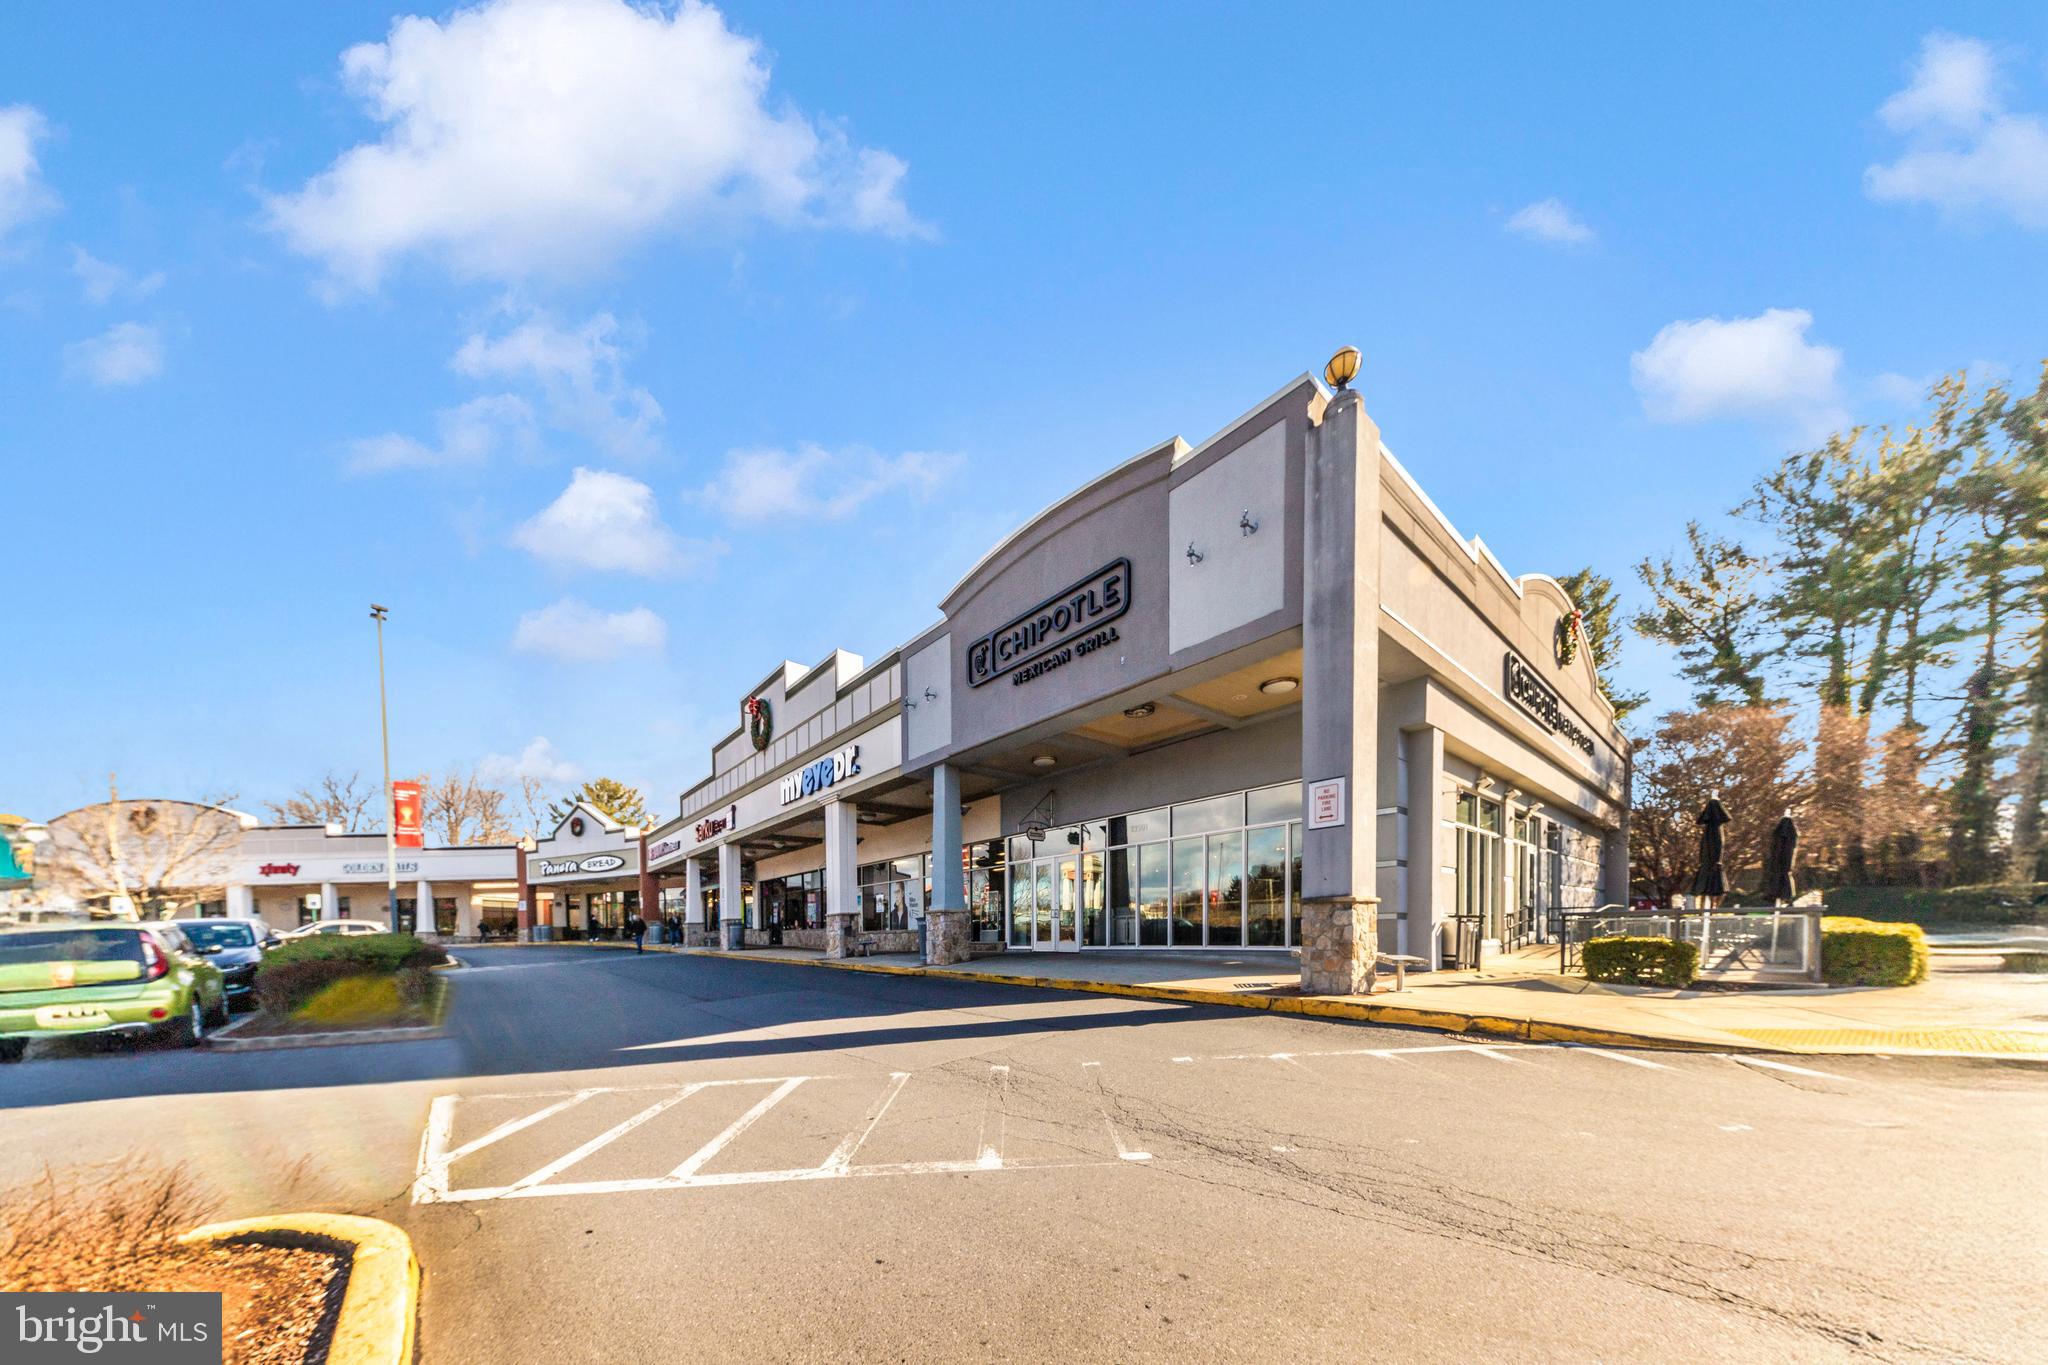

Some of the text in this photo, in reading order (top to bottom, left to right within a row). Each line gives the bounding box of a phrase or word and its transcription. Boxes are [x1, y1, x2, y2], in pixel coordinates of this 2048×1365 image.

[998, 575, 1121, 661] CHIPOTLE
[1012, 627, 1120, 686] MEXICAN GRILL
[540, 859, 616, 877] Panera BREAD
